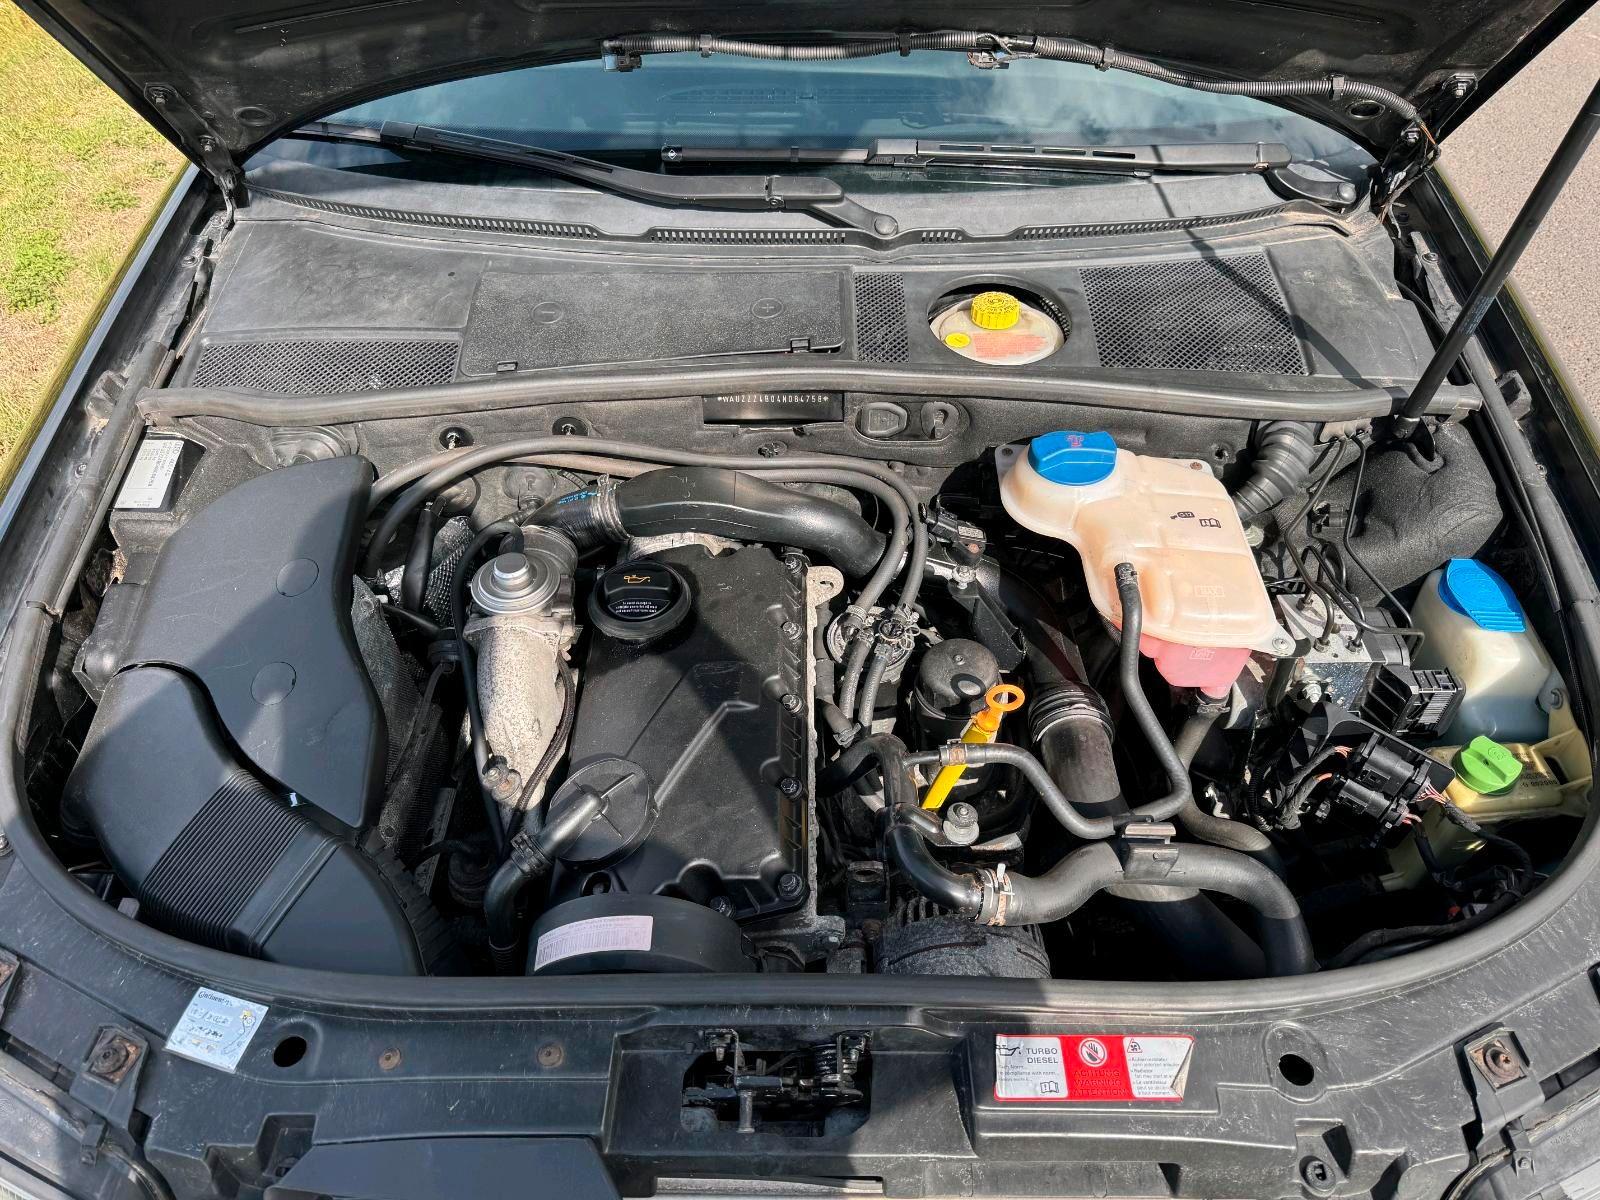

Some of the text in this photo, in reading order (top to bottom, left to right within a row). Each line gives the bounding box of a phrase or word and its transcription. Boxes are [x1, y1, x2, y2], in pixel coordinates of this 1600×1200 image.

[1026, 1047, 1058, 1055] TURBO
[1027, 1056, 1059, 1064] DIESEL
[1073, 1069, 1120, 1077] ACHTUNG
[1073, 1088, 1127, 1096] ATTENTION
